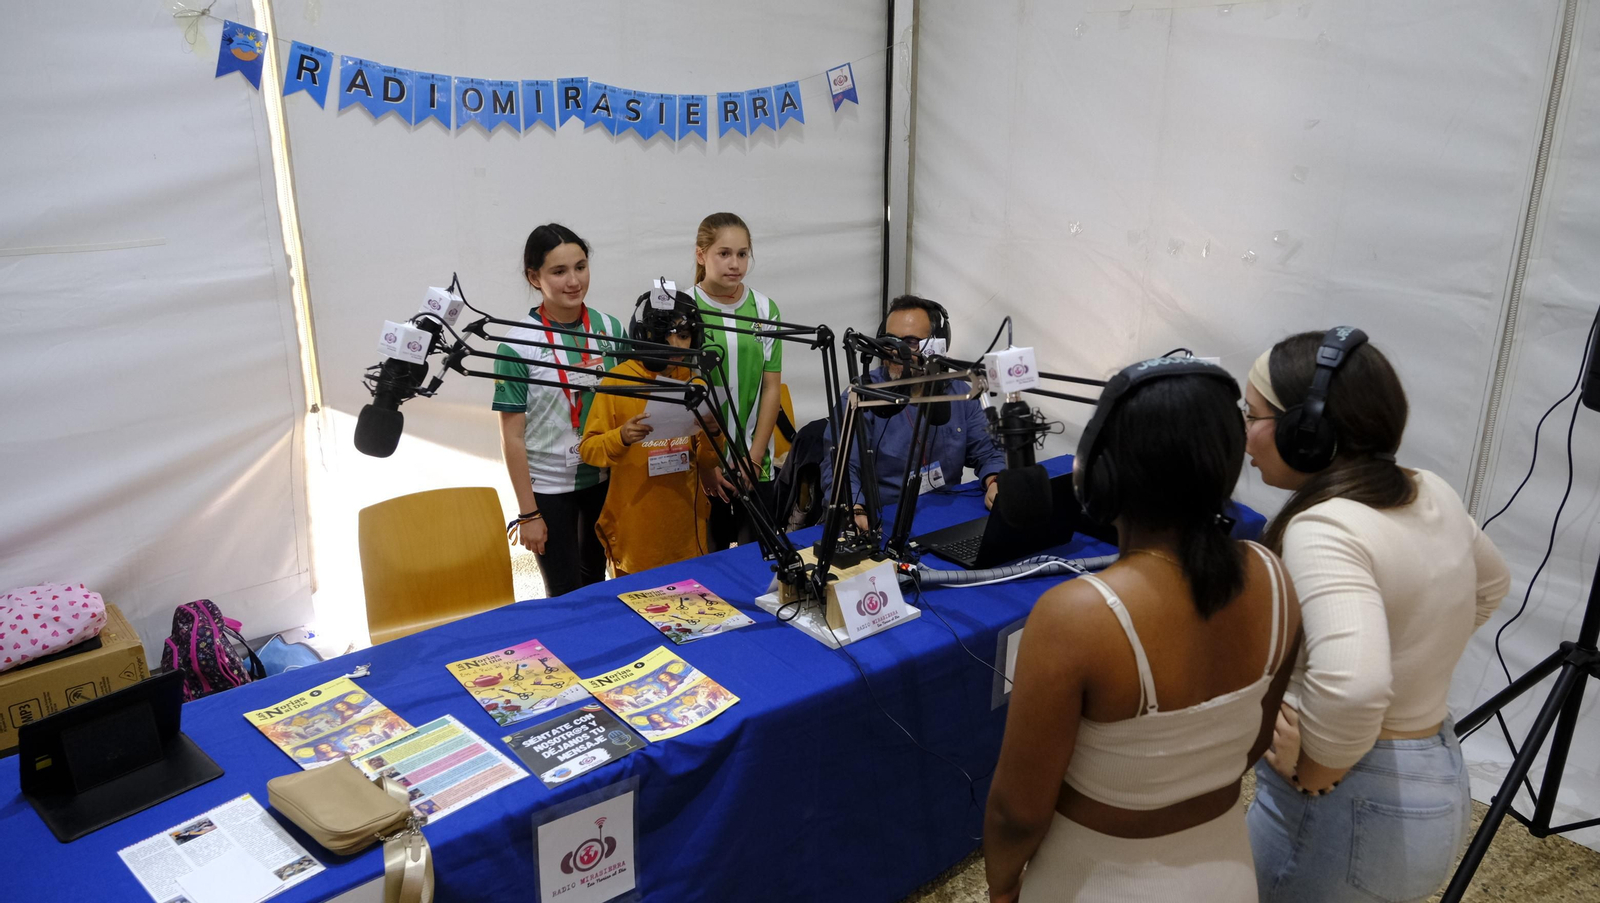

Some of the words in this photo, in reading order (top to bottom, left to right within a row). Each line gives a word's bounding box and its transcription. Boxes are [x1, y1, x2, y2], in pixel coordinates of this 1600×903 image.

[463, 654, 500, 669] Norias
[596, 668, 632, 687] Norias
[19, 703, 34, 723] MP3
[264, 696, 306, 719] Norias
[522, 722, 573, 748] SIÉNTATE
[573, 713, 595, 725] CON
[532, 724, 589, 753] NOSOTR@S
[541, 733, 590, 759] DÉJANOS
[589, 725, 606, 736] TU
[556, 734, 607, 762] MENSAJE
[552, 882, 577, 898] RADIO
[579, 860, 626, 885] MIRASIERRA
